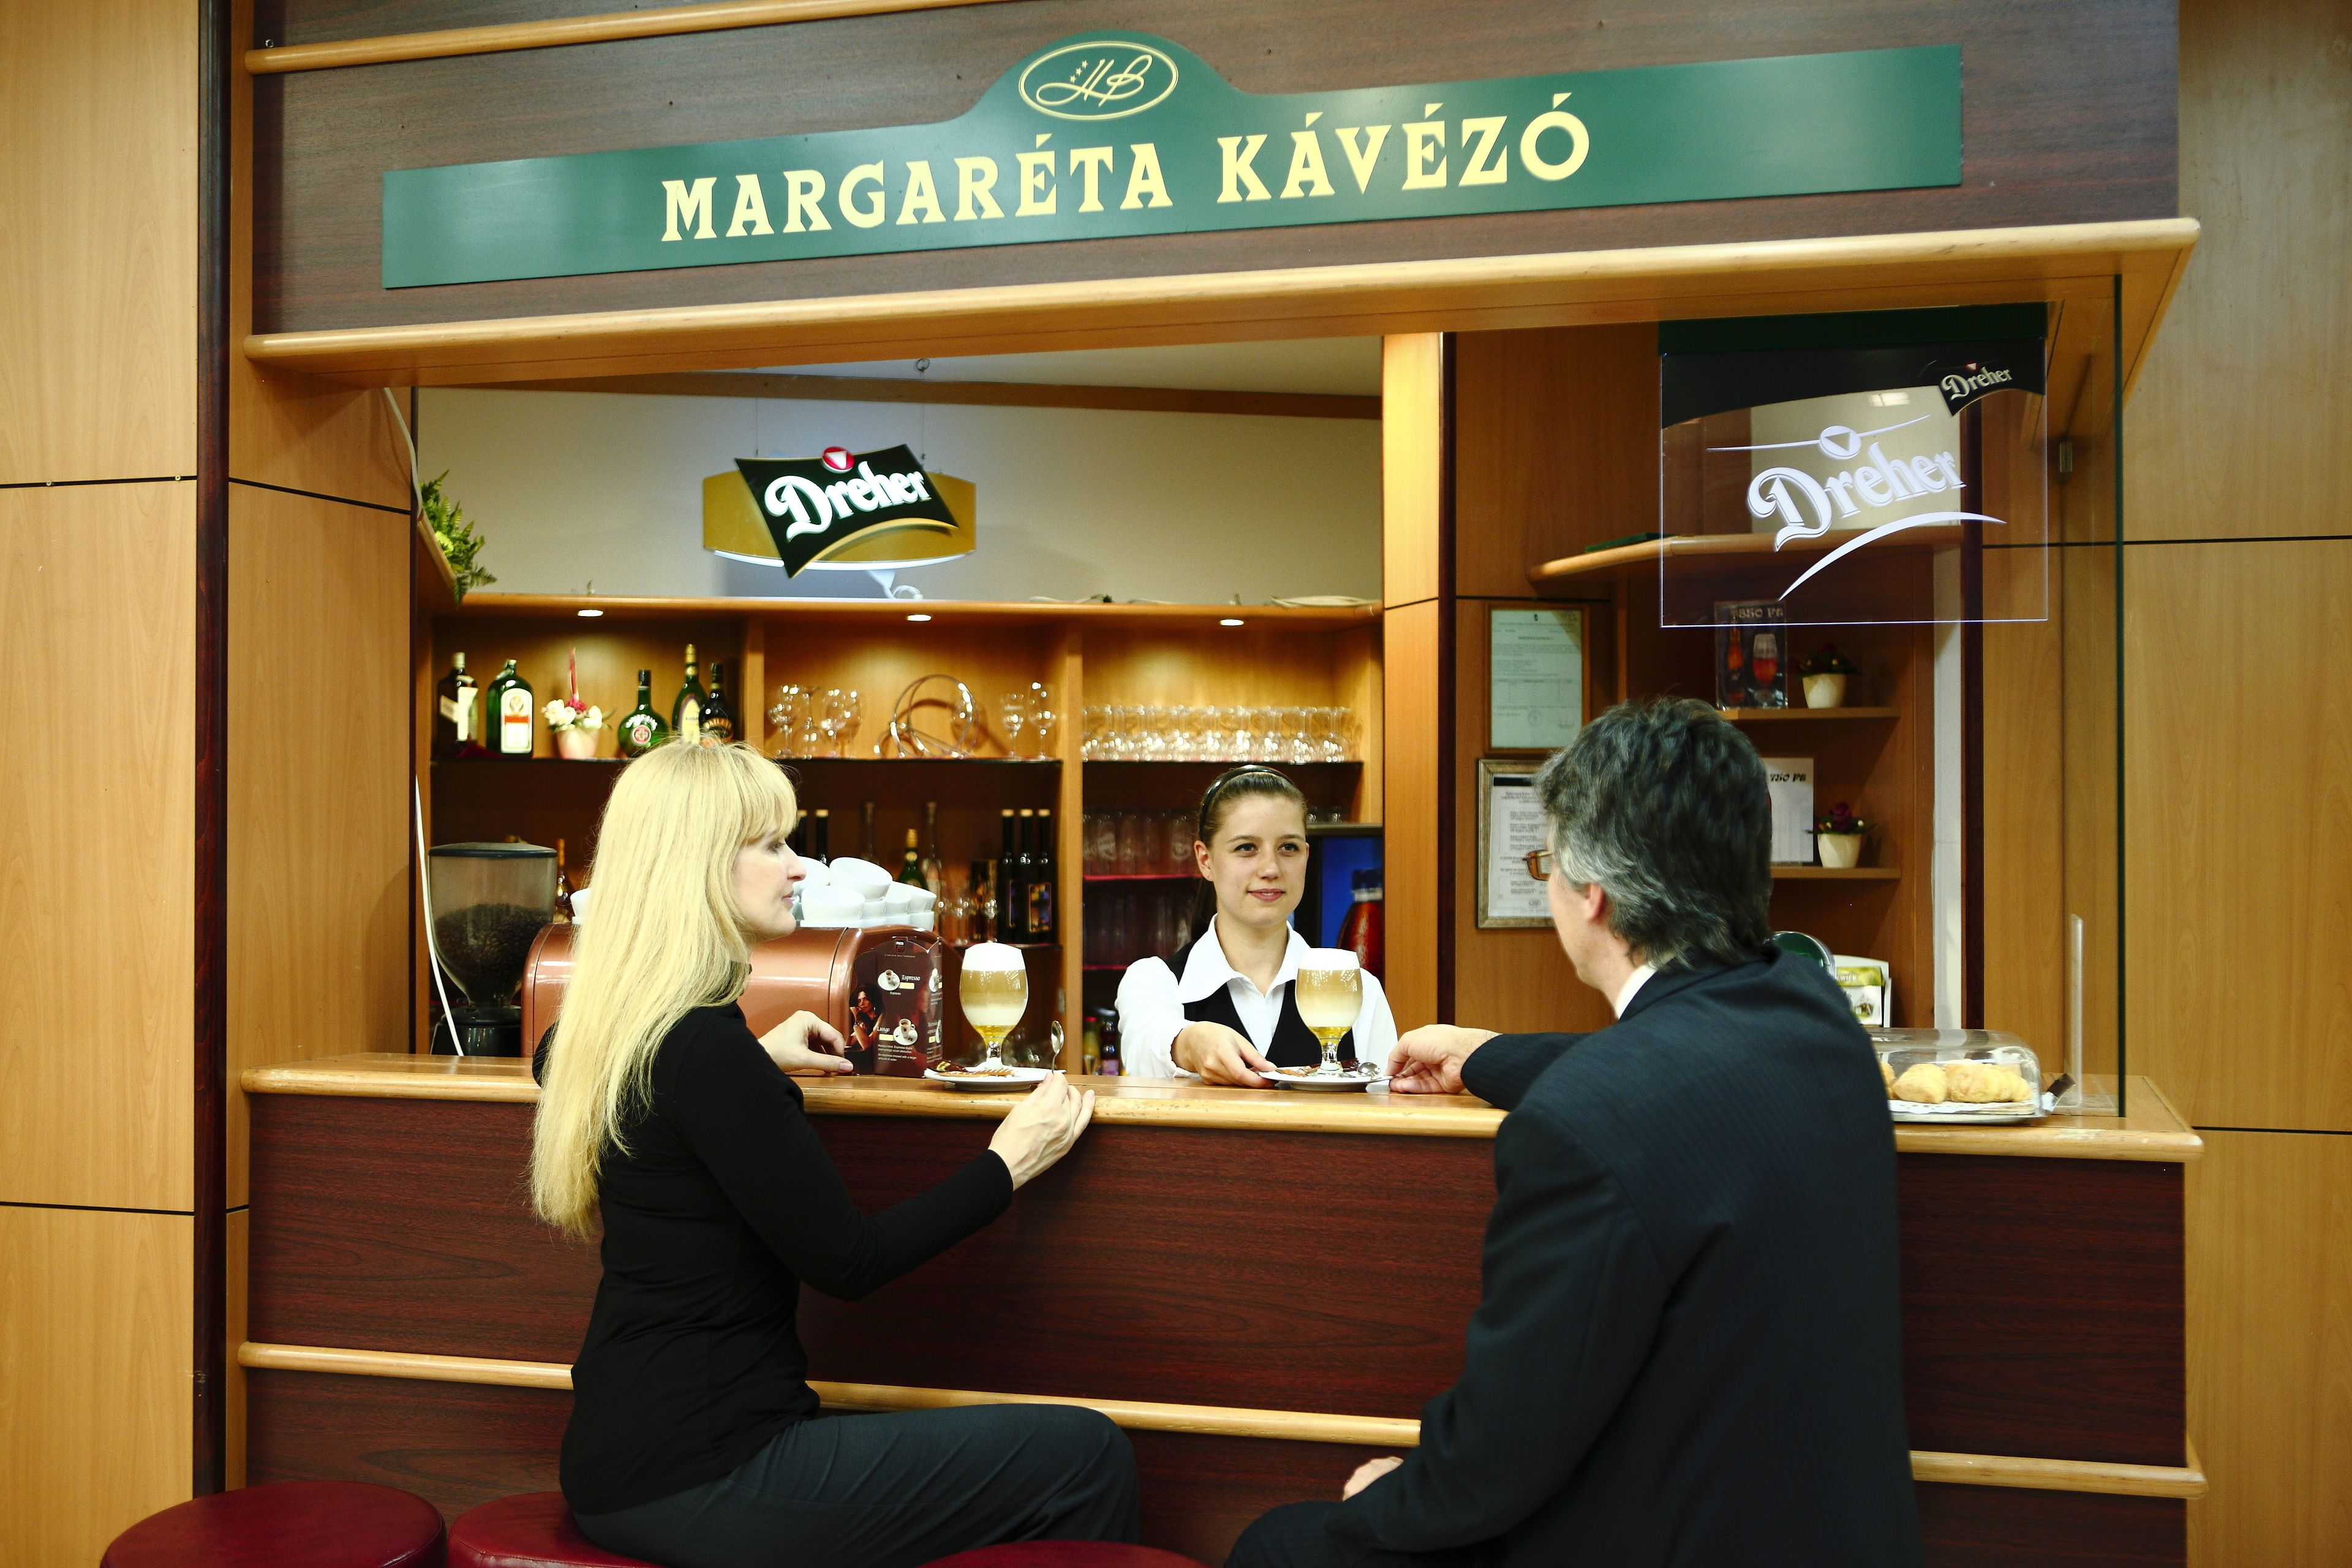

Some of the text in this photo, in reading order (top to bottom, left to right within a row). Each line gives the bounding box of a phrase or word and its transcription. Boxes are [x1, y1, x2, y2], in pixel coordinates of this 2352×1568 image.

[662, 92, 1590, 242] MARGARÉTA KÁVÉZÓ
[1940, 366, 2013, 401] Dreher
[764, 460, 932, 543] Dreher
[1747, 442, 1967, 552] Dreher
